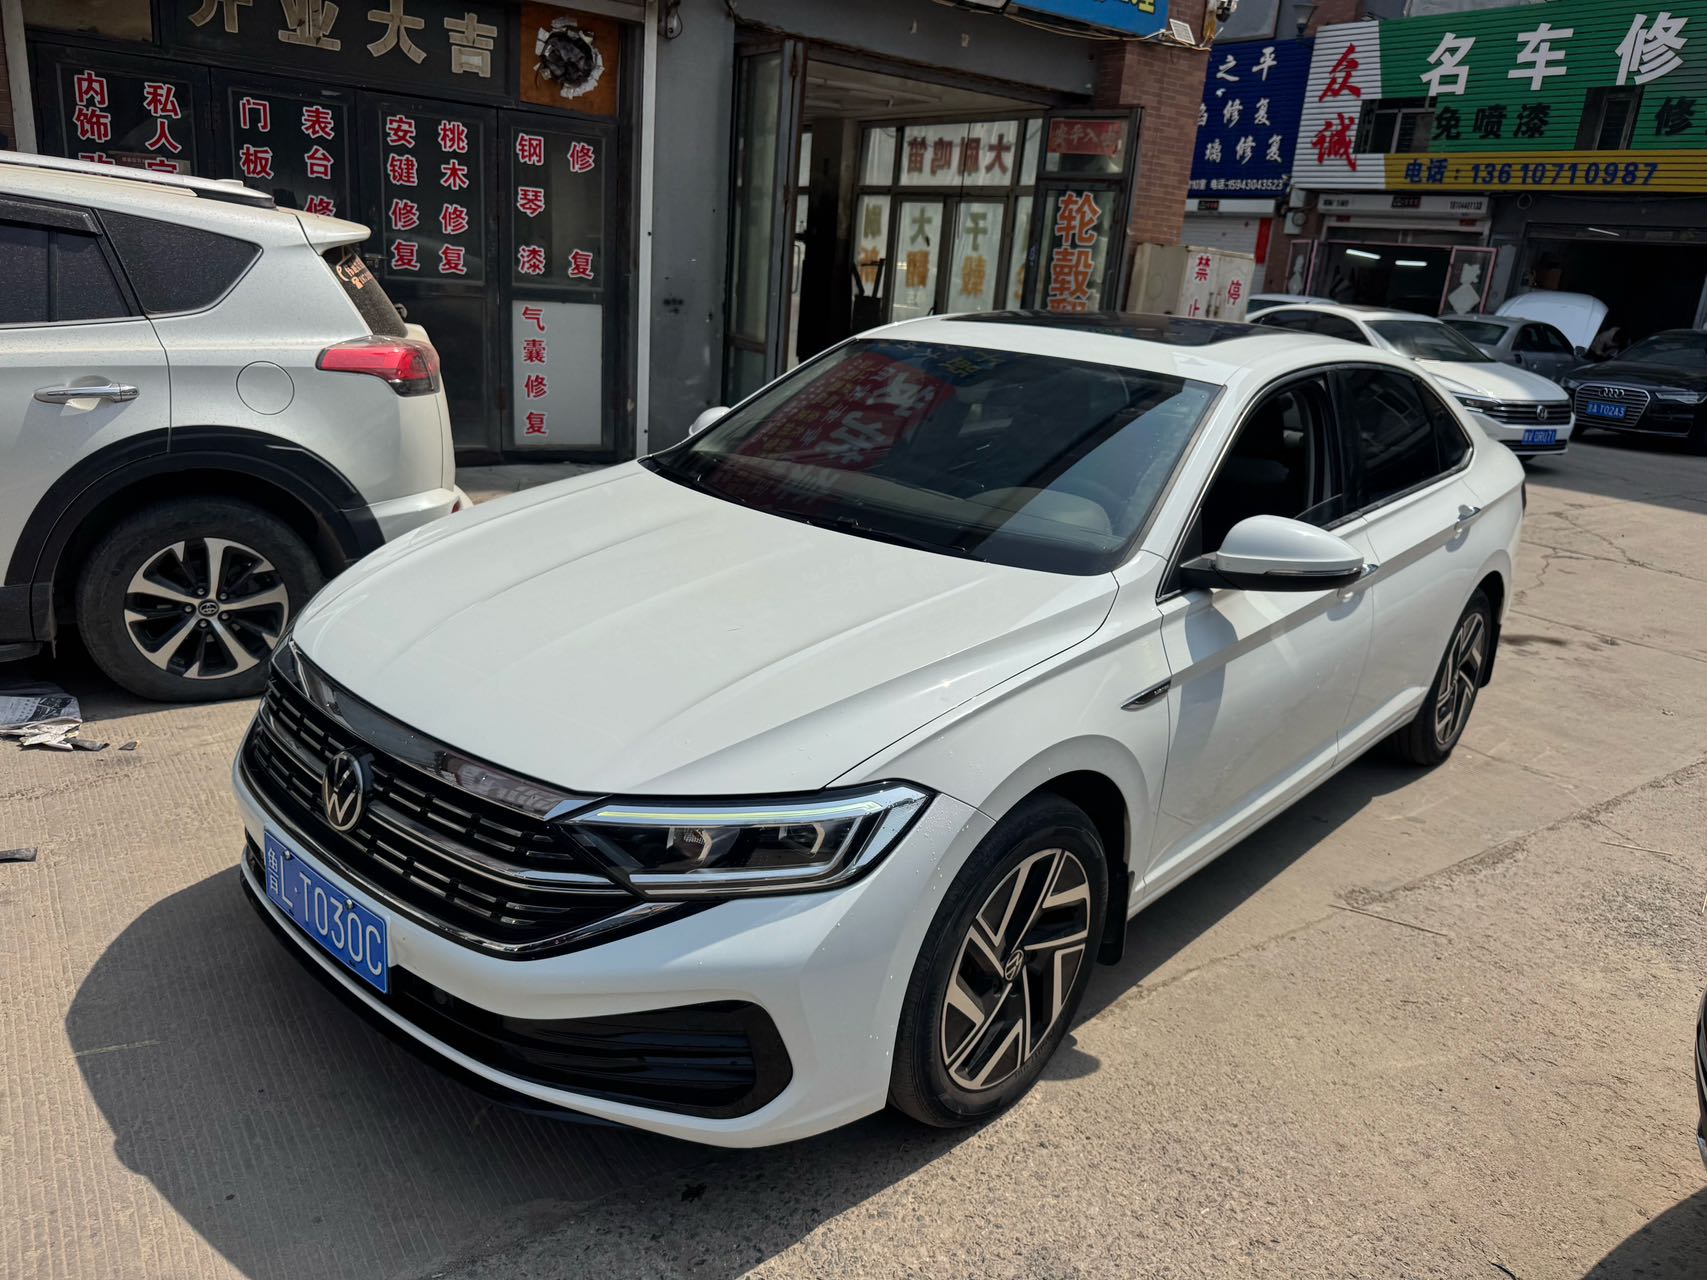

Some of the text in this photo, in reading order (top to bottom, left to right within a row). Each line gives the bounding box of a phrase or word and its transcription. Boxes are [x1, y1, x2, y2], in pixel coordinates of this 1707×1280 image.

[1312, 43, 1361, 172] 众诚
[1420, 12, 1689, 97] 名车修
[239, 97, 274, 179] 门板
[1431, 102, 1551, 141] 免喷漆
[386, 115, 420, 272] 安键修复
[438, 120, 469, 275] 桃木修复
[517, 132, 546, 275] 钢琴漆
[567, 142, 595, 280] 修复
[1048, 191, 1102, 312] 轮毂
[521, 306, 549, 436] 气囊修复
